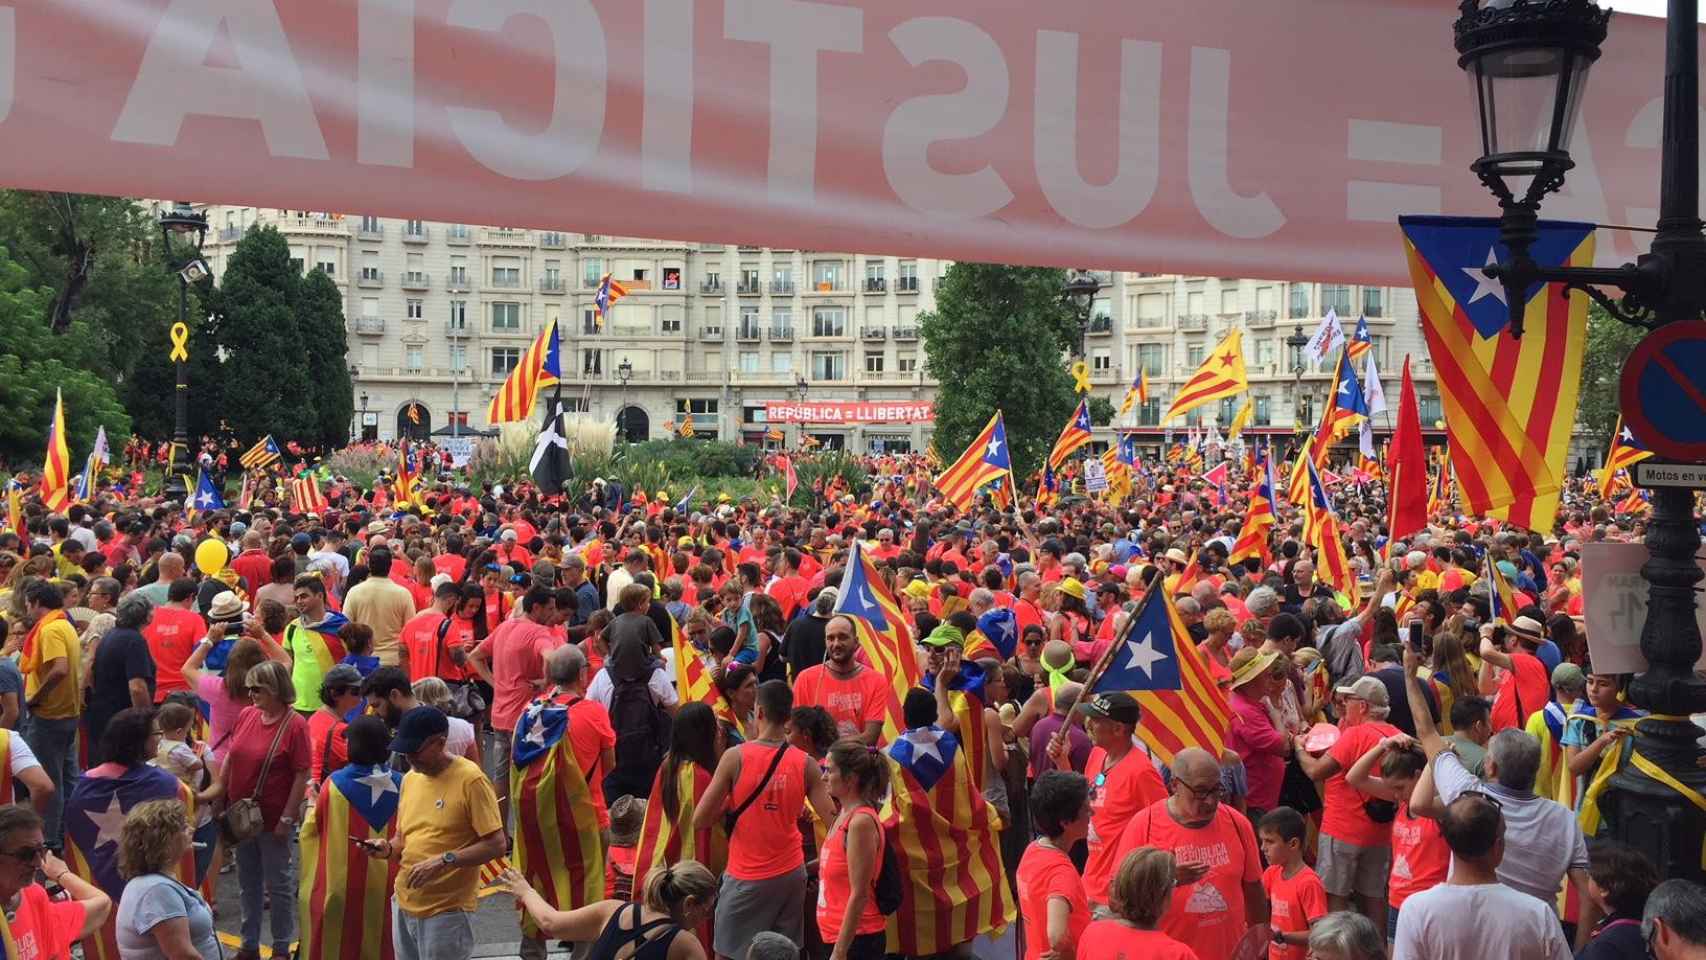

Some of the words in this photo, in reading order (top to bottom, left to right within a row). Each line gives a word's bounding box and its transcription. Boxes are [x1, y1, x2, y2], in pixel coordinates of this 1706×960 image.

[769, 403, 842, 420] REPÚBLICA
[856, 405, 930, 420] LLIBERTAT
[1646, 469, 1679, 481] Motos
[1682, 472, 1695, 481] en
